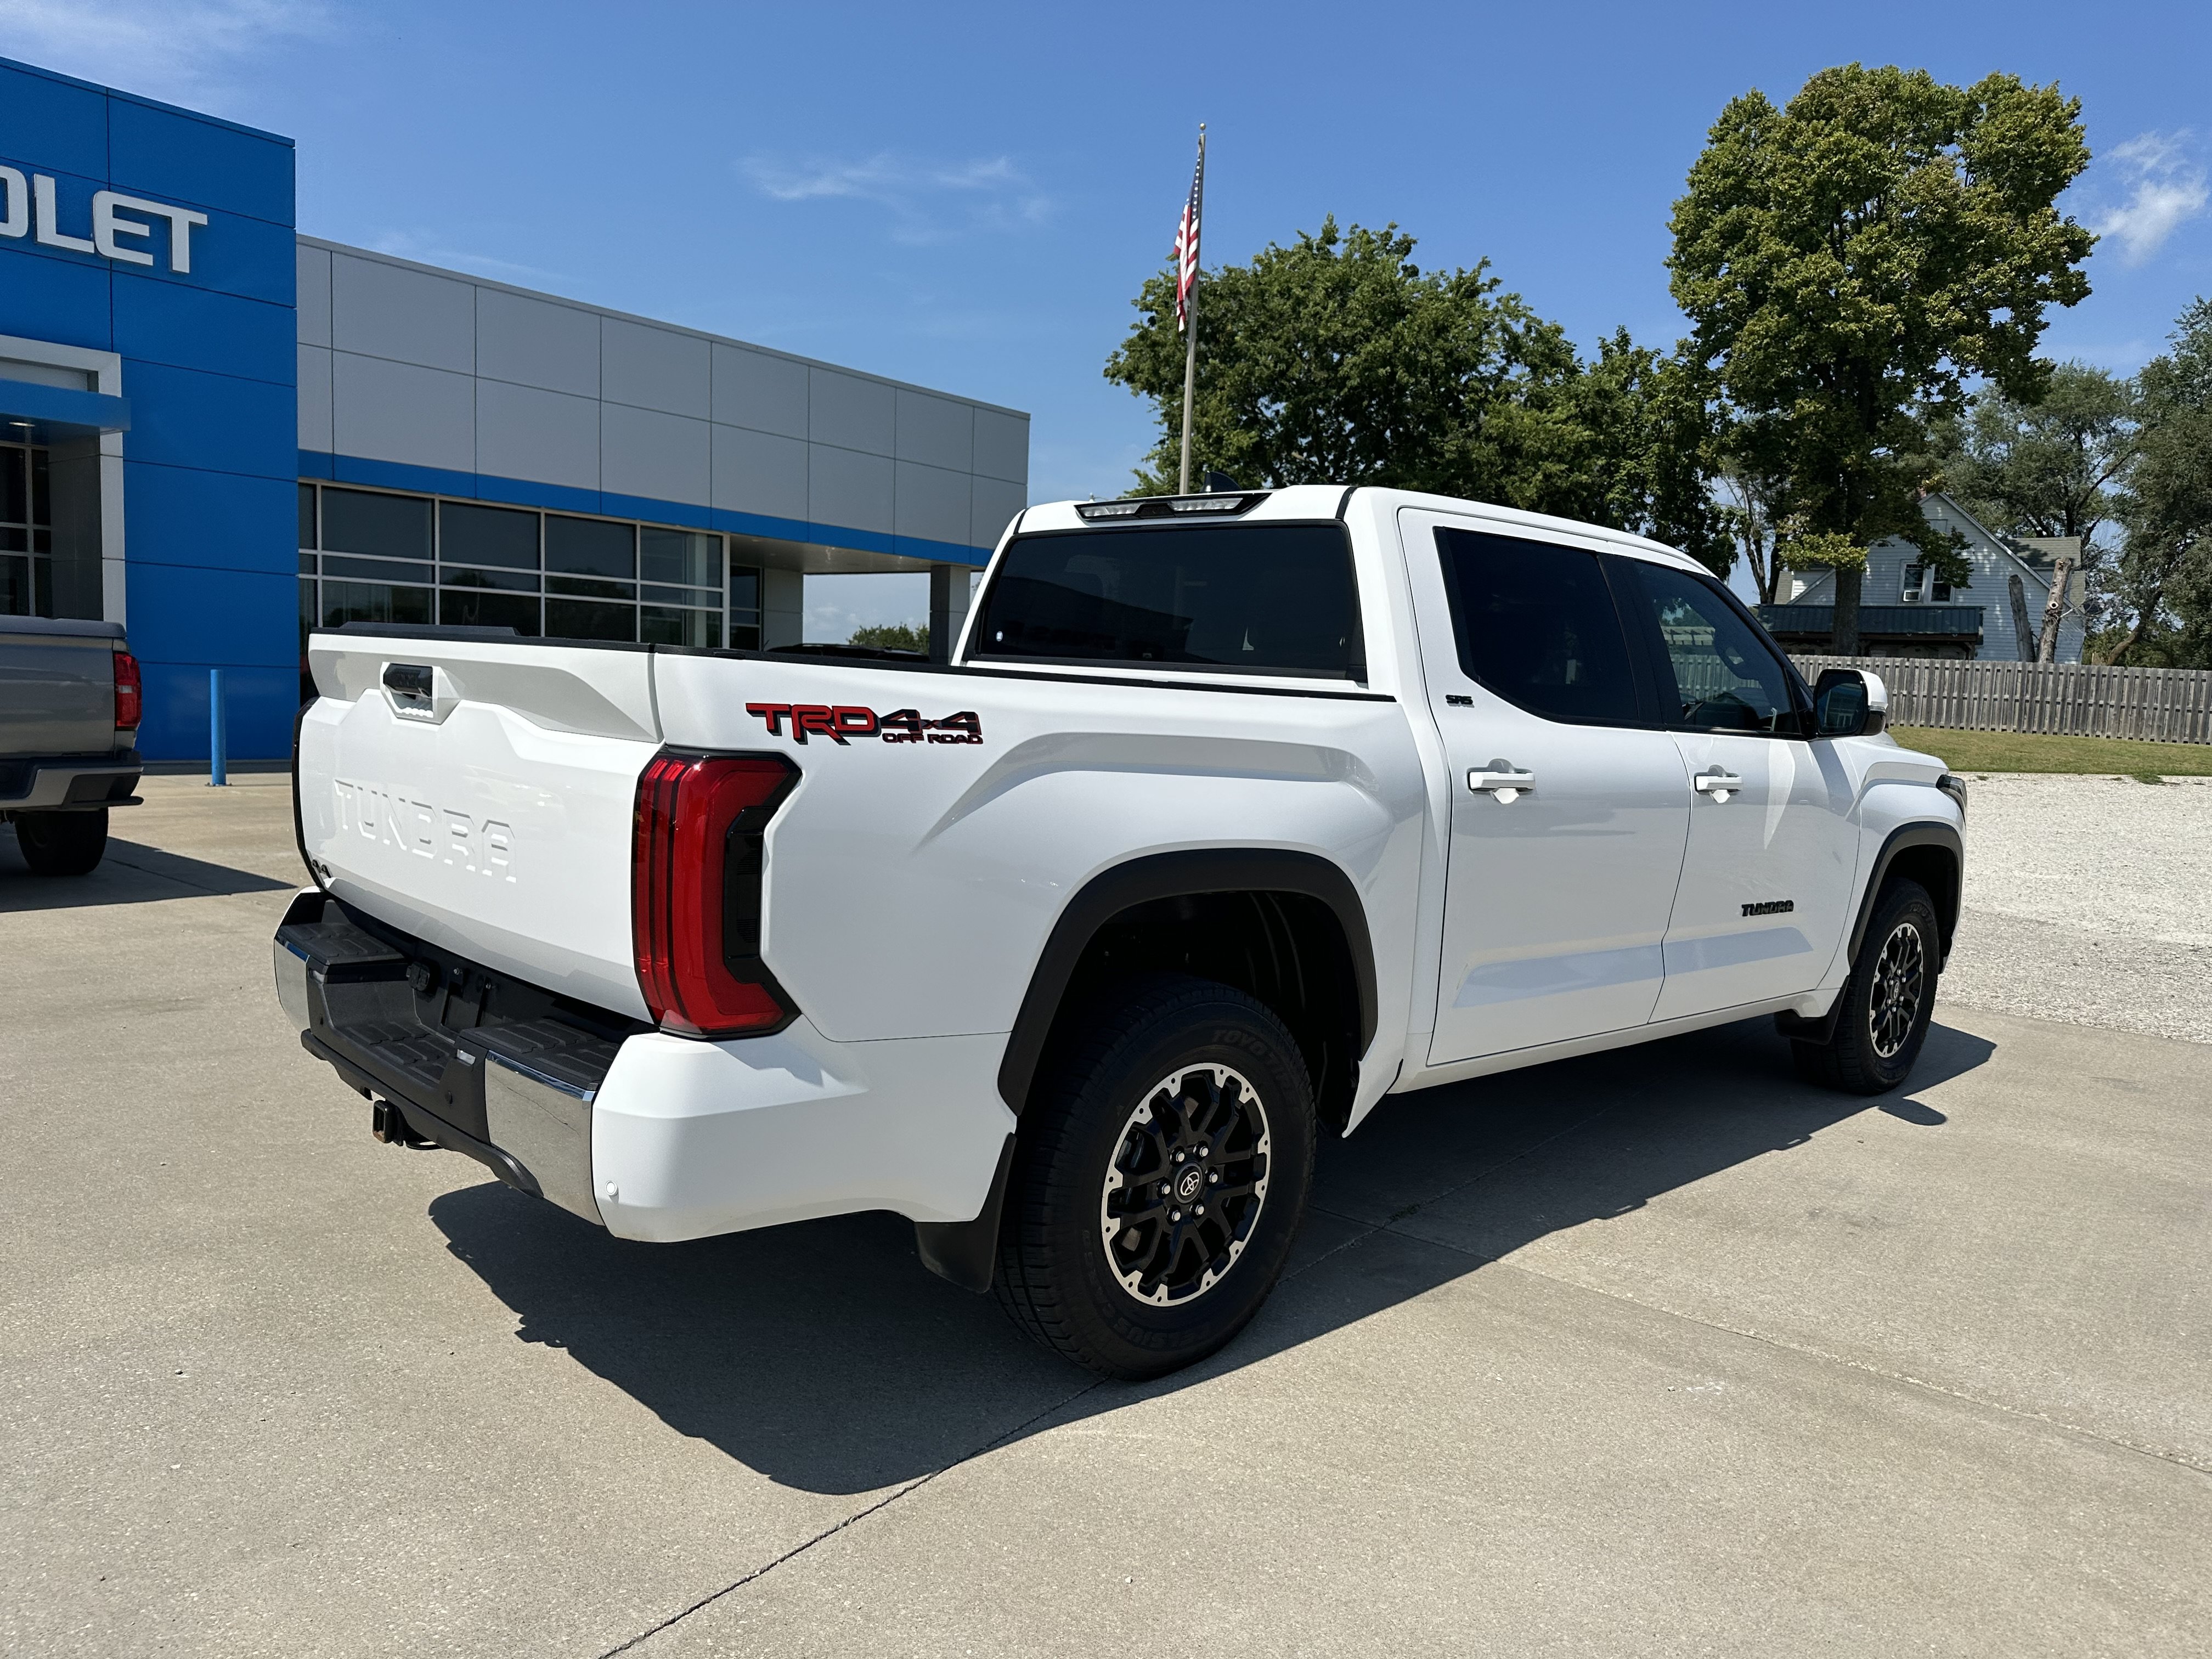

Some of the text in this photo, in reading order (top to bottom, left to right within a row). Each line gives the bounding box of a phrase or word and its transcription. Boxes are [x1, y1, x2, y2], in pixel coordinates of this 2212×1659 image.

[1445, 694, 1474, 706] SR5
[746, 702, 881, 746] TRD
[882, 732, 984, 745] OFF ROAD
[334, 779, 517, 883] TUNDRA
[1741, 900, 1794, 917] TUNDRA
[1211, 1028, 1269, 1057] TOYO
